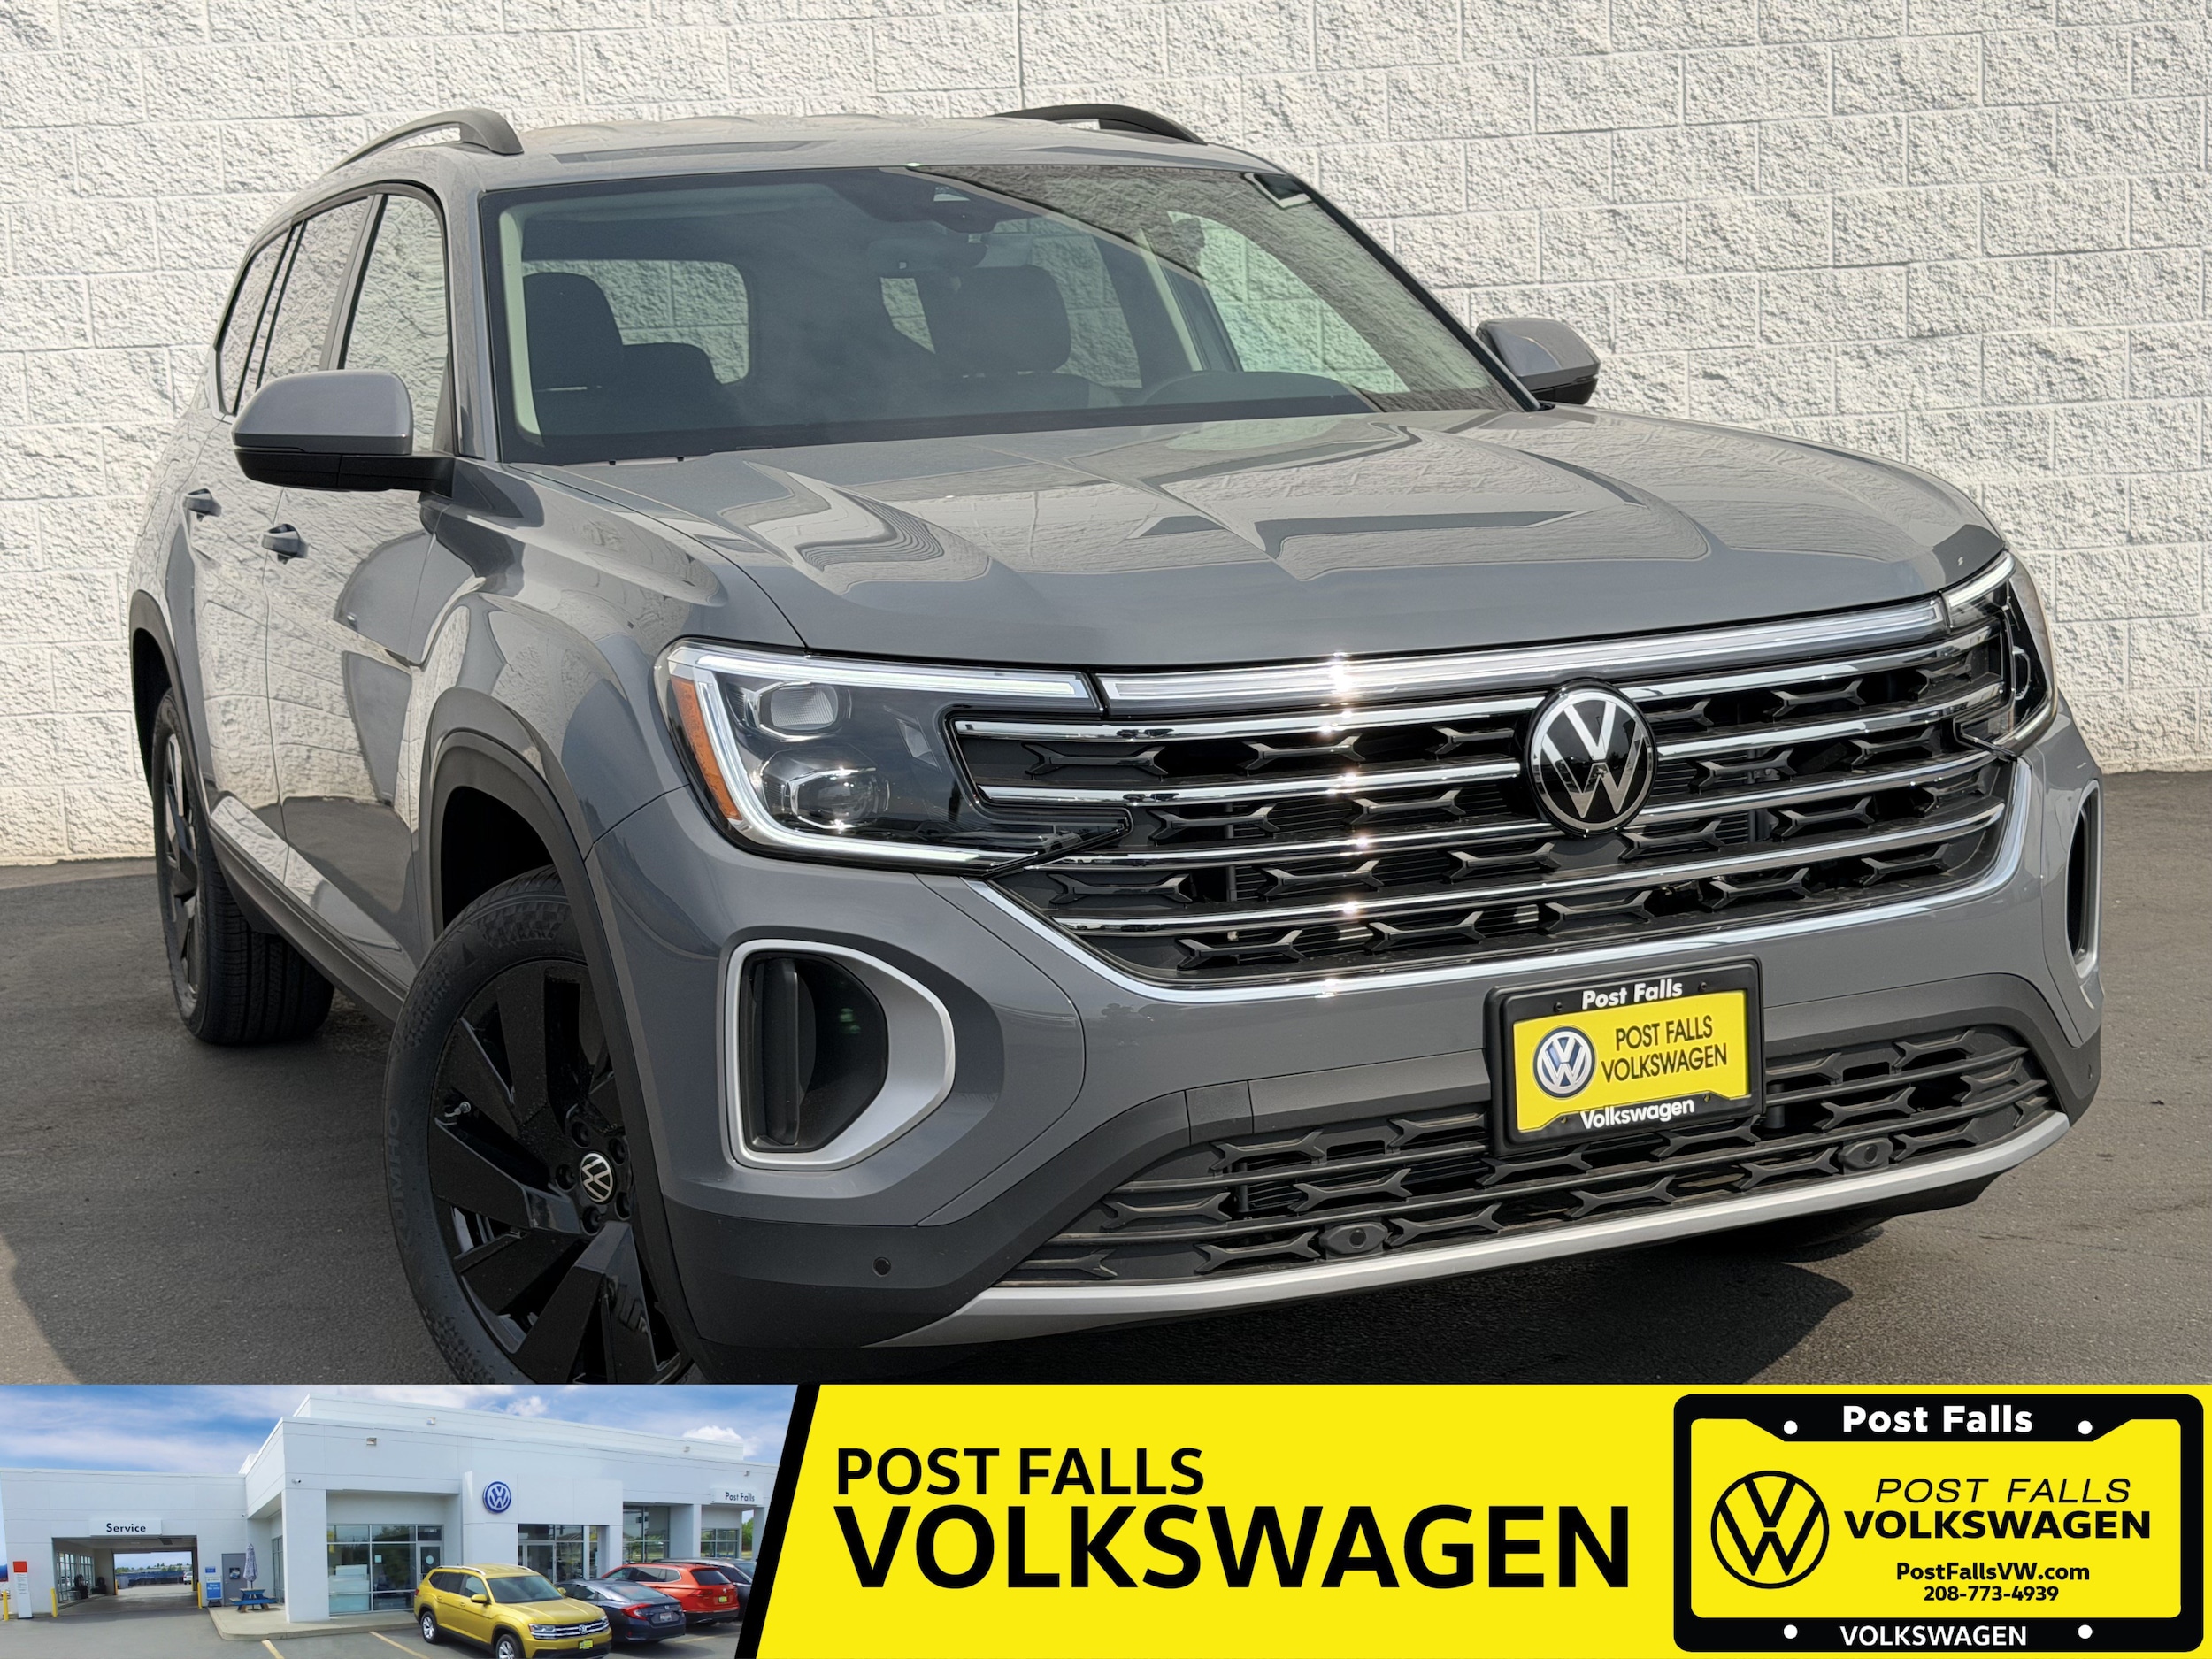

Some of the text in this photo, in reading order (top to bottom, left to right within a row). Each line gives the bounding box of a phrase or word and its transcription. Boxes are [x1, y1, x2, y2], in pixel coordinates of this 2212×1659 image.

[1582, 978, 1683, 1010] Post Falls
[1616, 1015, 1713, 1051] POST FALLS
[1600, 1042, 1727, 1083] VOLKSWAGEN
[1579, 1099, 1694, 1130] Volkswagen
[725, 1491, 755, 1502] Post Falls
[106, 1523, 146, 1532] Service
